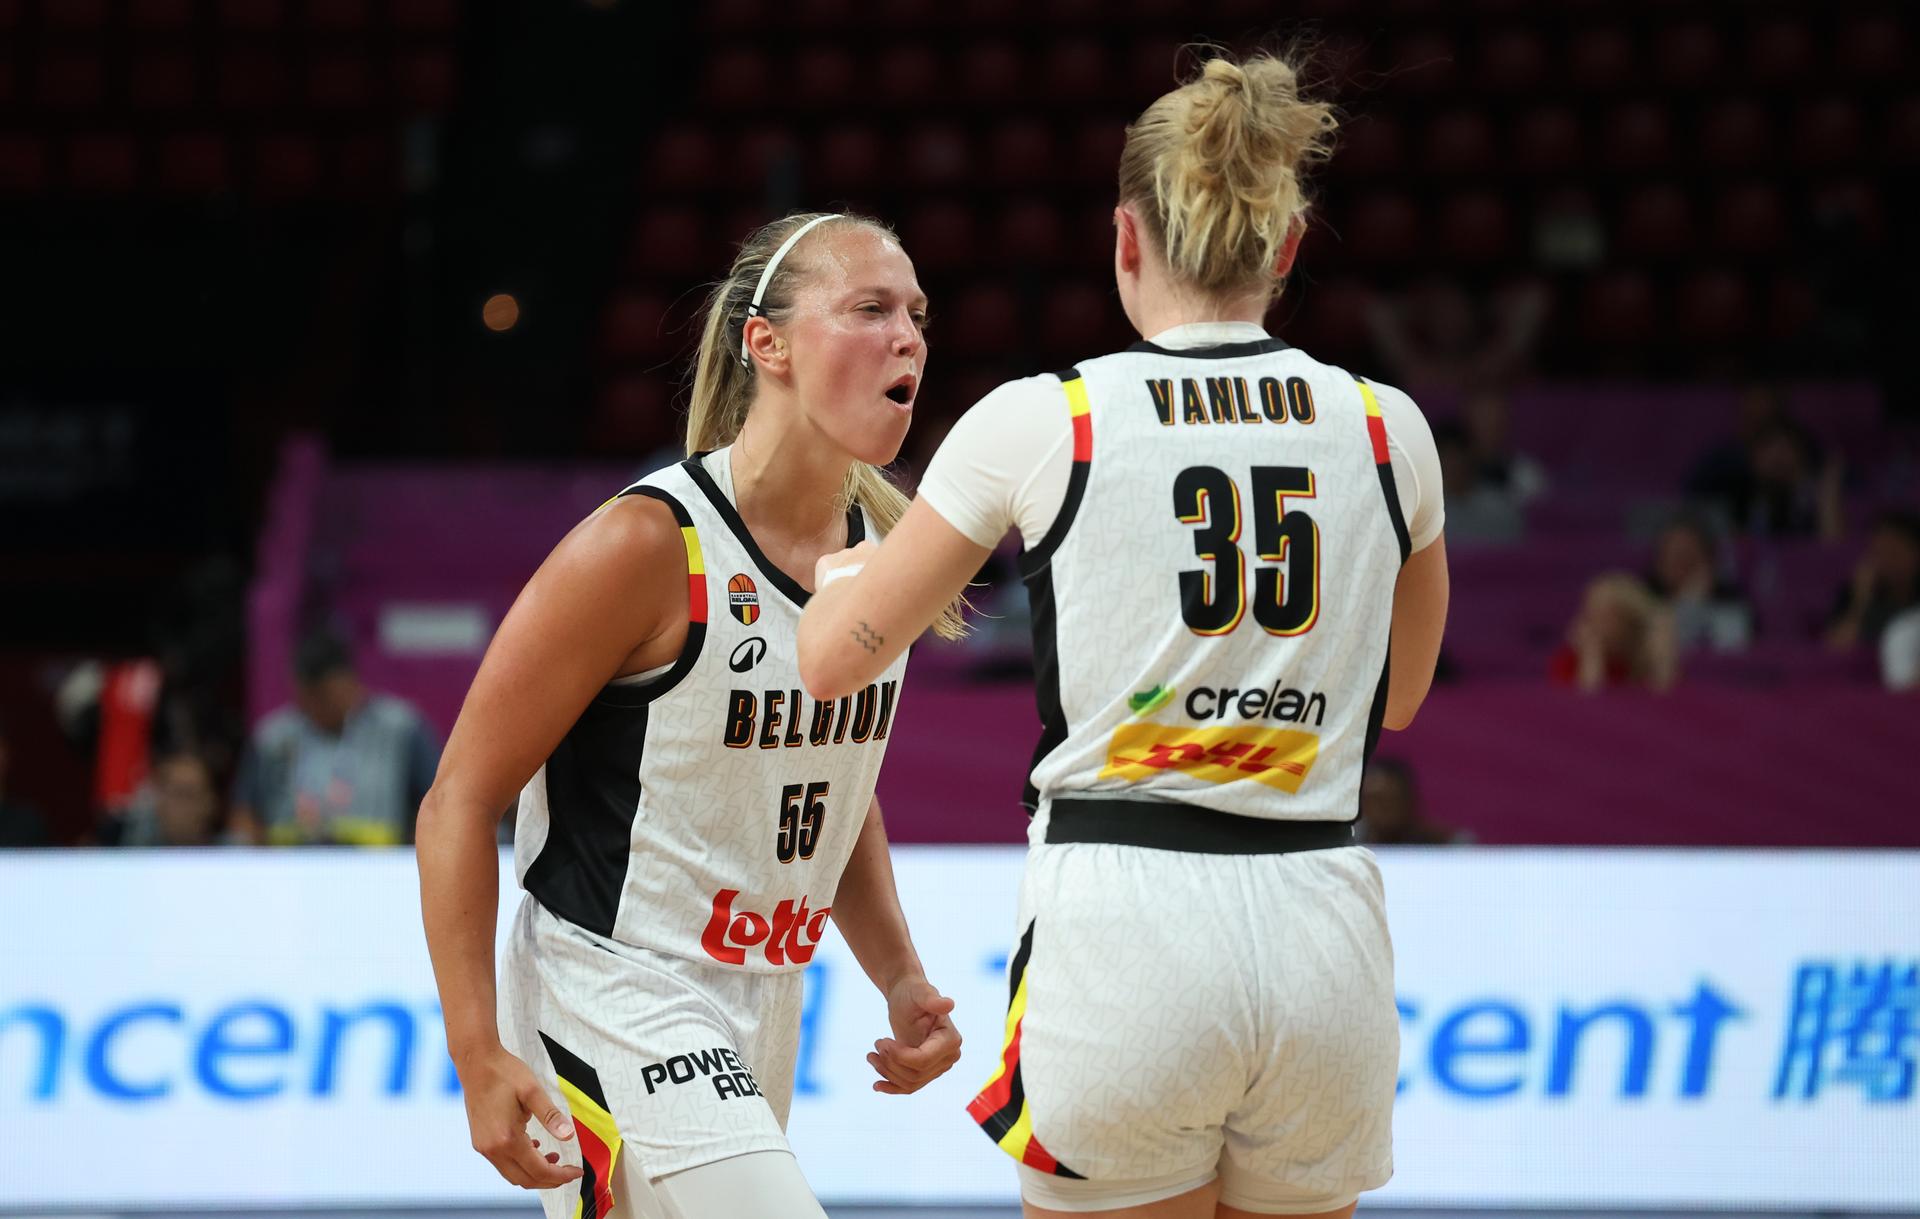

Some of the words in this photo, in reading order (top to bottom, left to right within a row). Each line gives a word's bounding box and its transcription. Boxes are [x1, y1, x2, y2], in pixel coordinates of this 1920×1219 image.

[1145, 376, 1316, 426] VANLOO
[1173, 465, 1321, 637] 35
[1185, 679, 1327, 726] crelan
[1141, 740, 1279, 774] DHL
[776, 781, 830, 864] 55
[701, 888, 832, 966] Lotto
[0, 1000, 465, 1099] ncen
